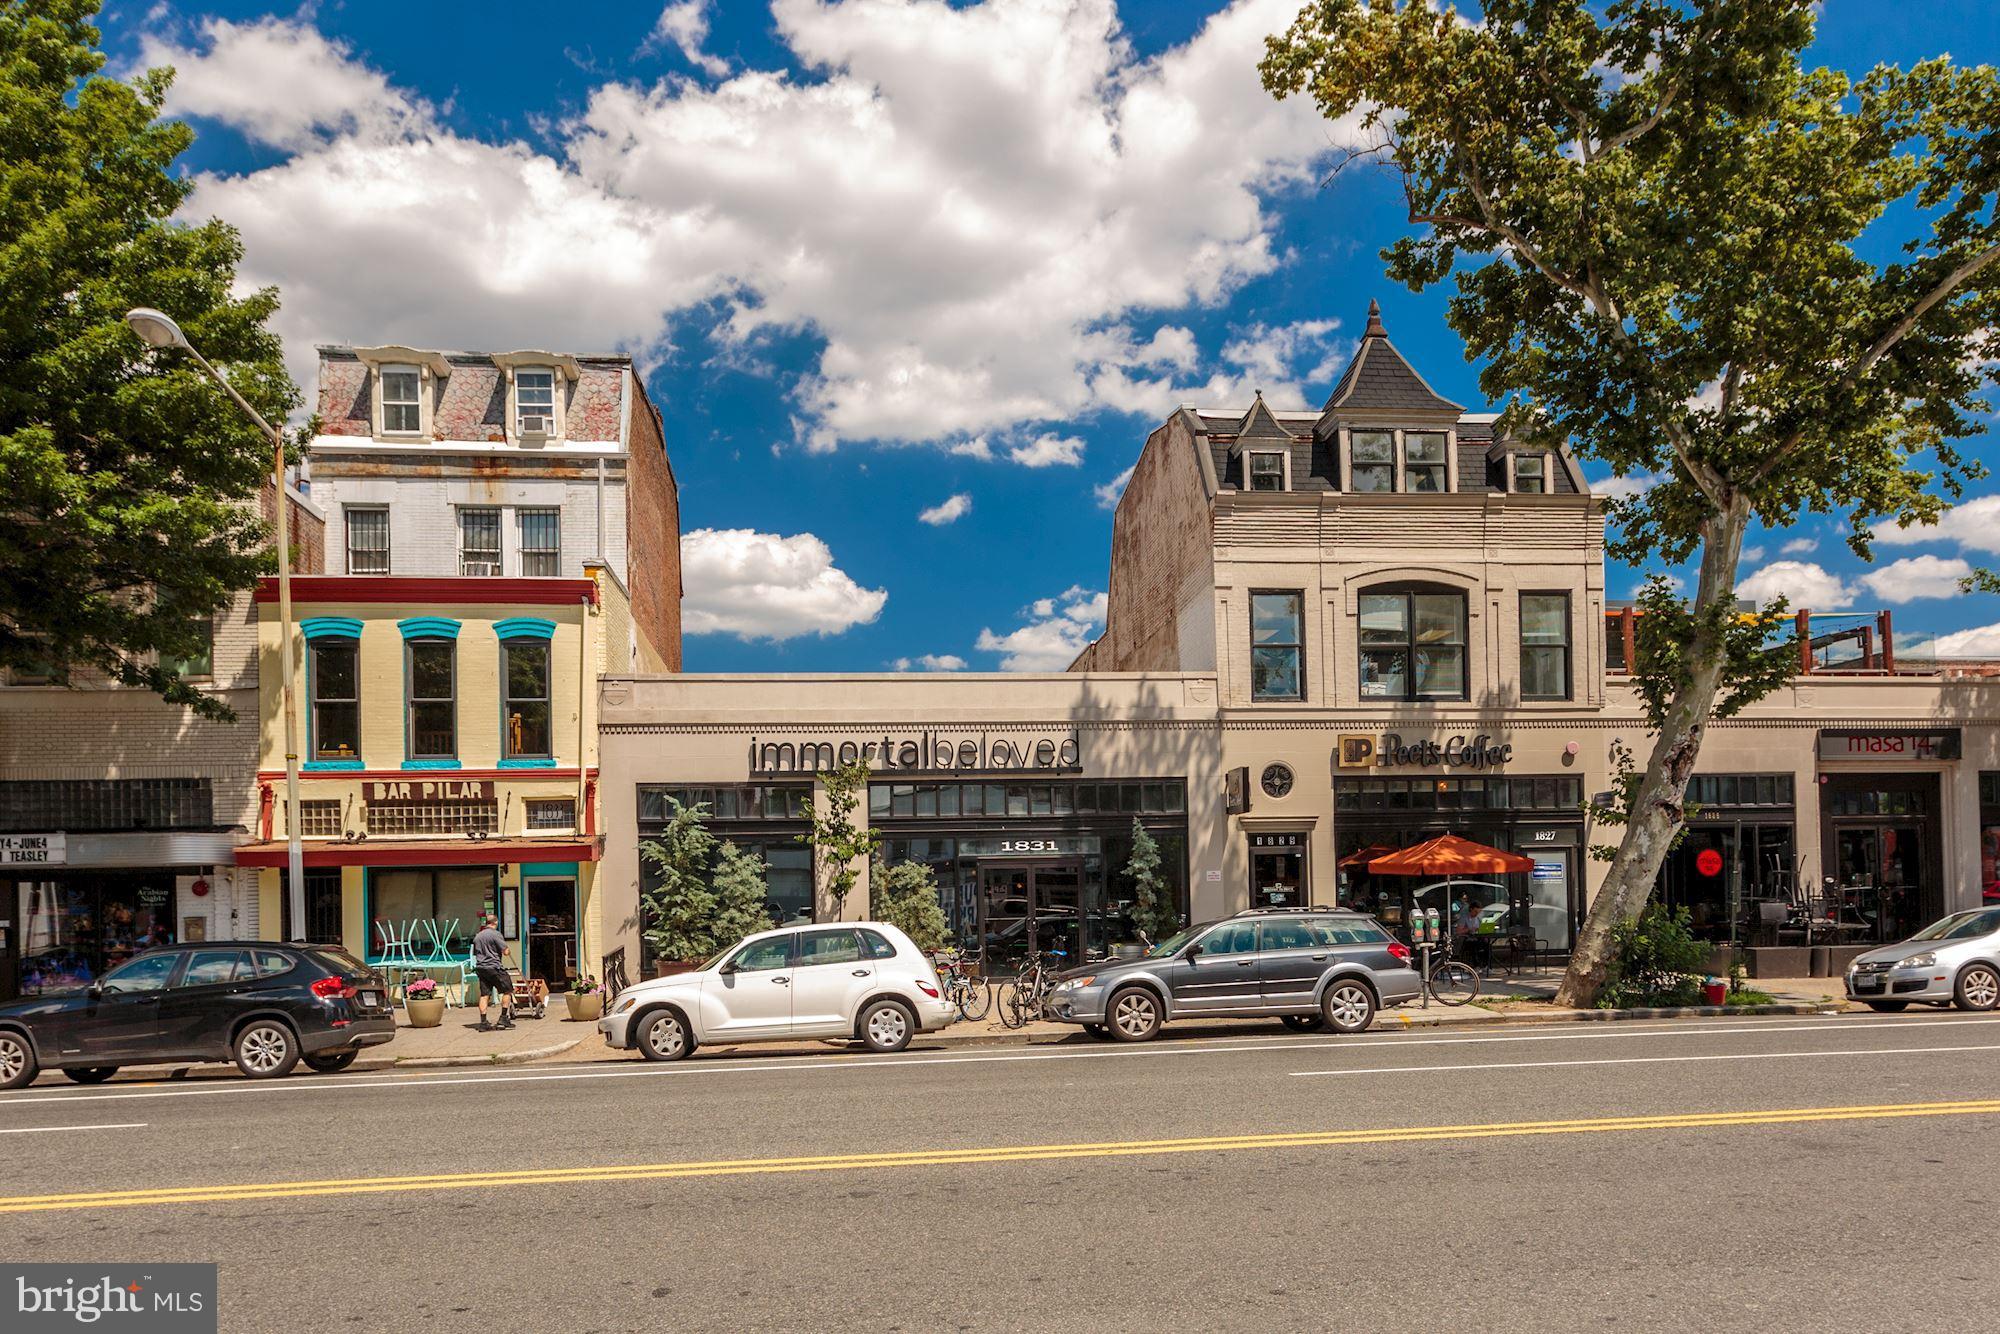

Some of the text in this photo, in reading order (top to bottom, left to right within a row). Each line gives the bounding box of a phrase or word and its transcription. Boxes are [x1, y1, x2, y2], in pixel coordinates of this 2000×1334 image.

[751, 730, 1079, 769] immortalbeloved
[1381, 734, 1512, 770] Peet's Coffee
[373, 782, 482, 800] BAR PILAR
[1256, 836, 1296, 846] 1829
[1535, 831, 1556, 841] 1827
[1001, 840, 1059, 851] 1831
[10, 850, 48, 862] TEASLEY
